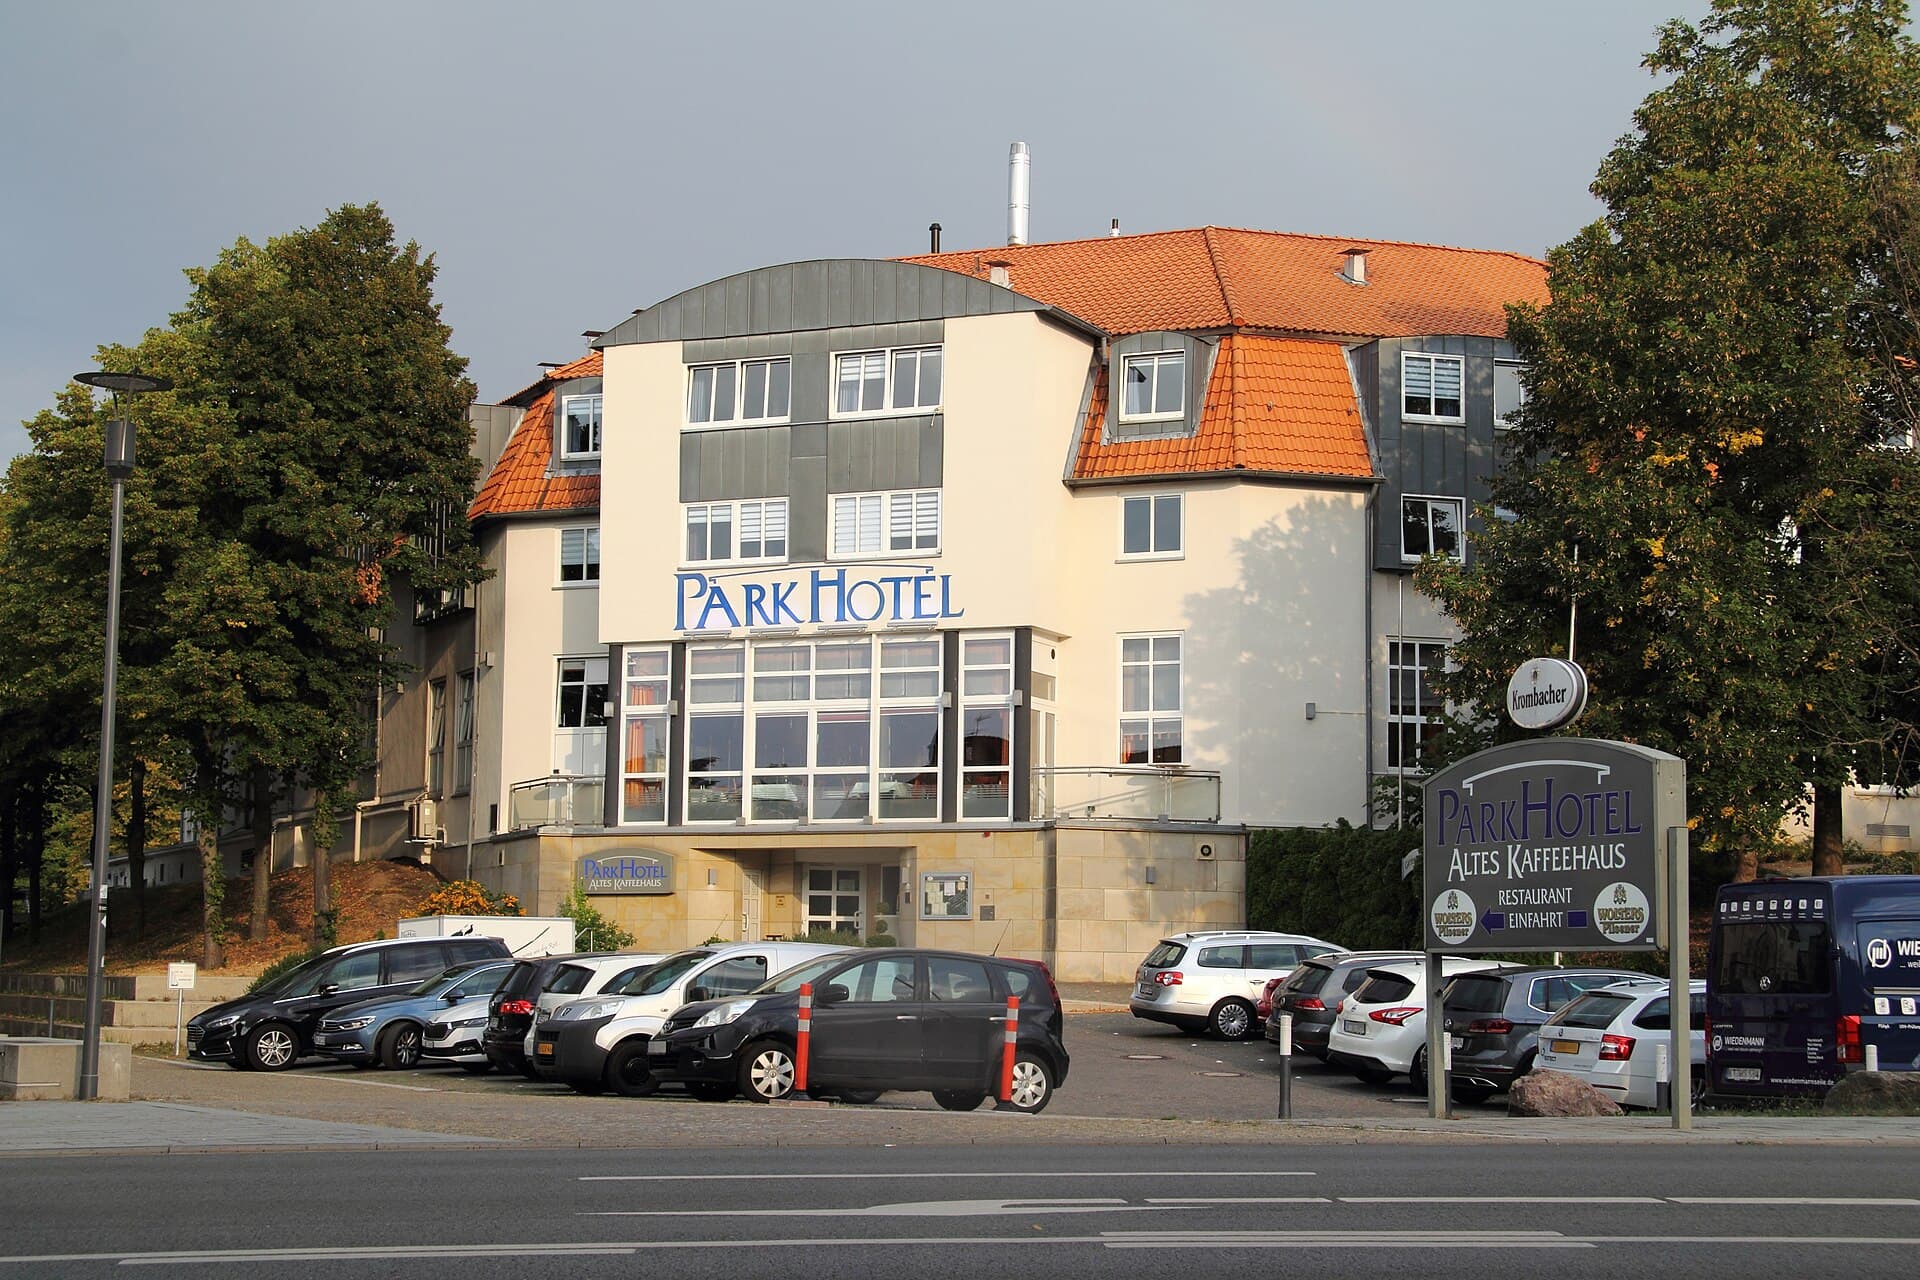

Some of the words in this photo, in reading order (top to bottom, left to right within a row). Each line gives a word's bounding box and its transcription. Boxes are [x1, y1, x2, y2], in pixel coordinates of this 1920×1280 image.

[1511, 684, 1567, 711] Krombacher
[1498, 887, 1573, 906] RESTAURANT
[1509, 911, 1564, 929] EINFAHRT
[1724, 1036, 1765, 1047] WIEDENMANN
